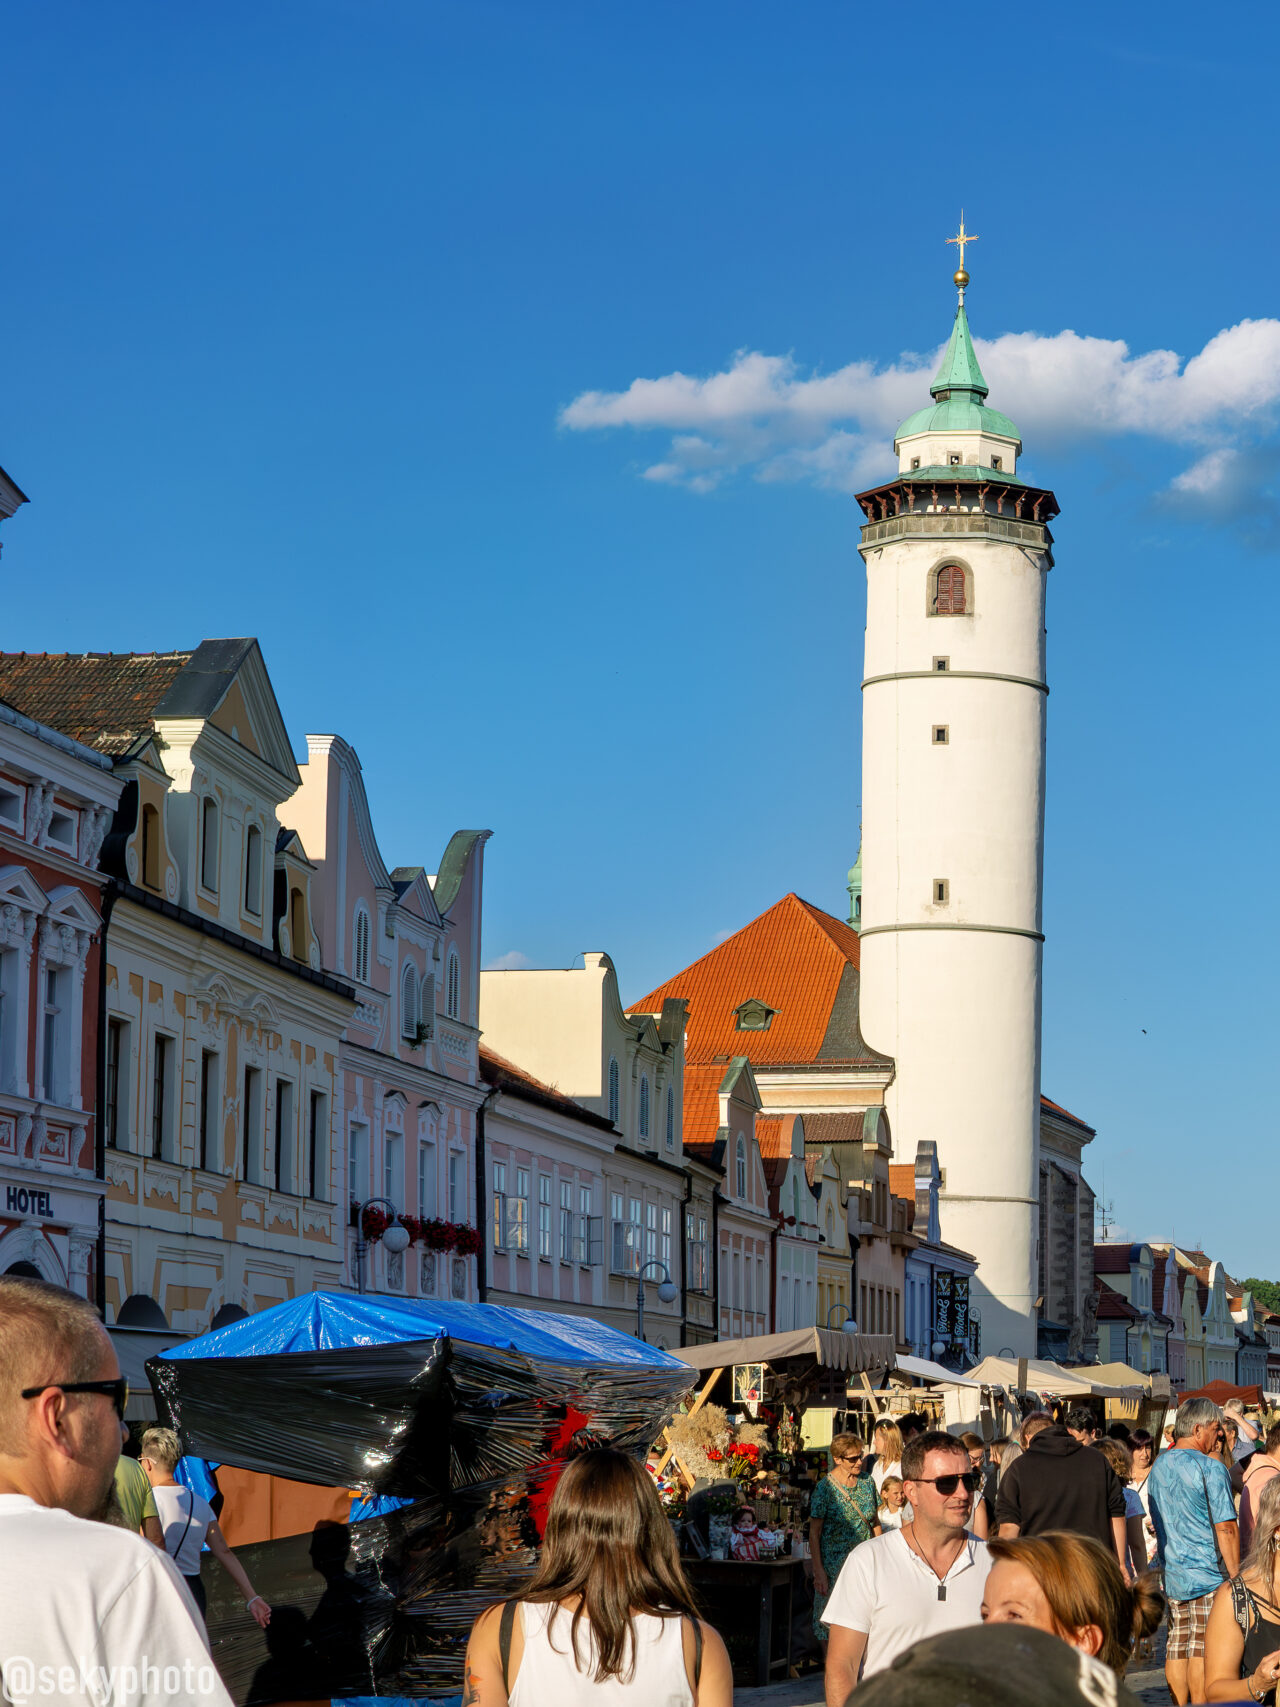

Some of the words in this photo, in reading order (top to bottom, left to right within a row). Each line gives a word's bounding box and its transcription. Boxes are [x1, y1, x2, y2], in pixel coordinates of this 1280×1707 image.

[7, 1186, 54, 1218] HOTEL
[937, 1298, 950, 1333] Hotel
[954, 1303, 967, 1336] Hotel
